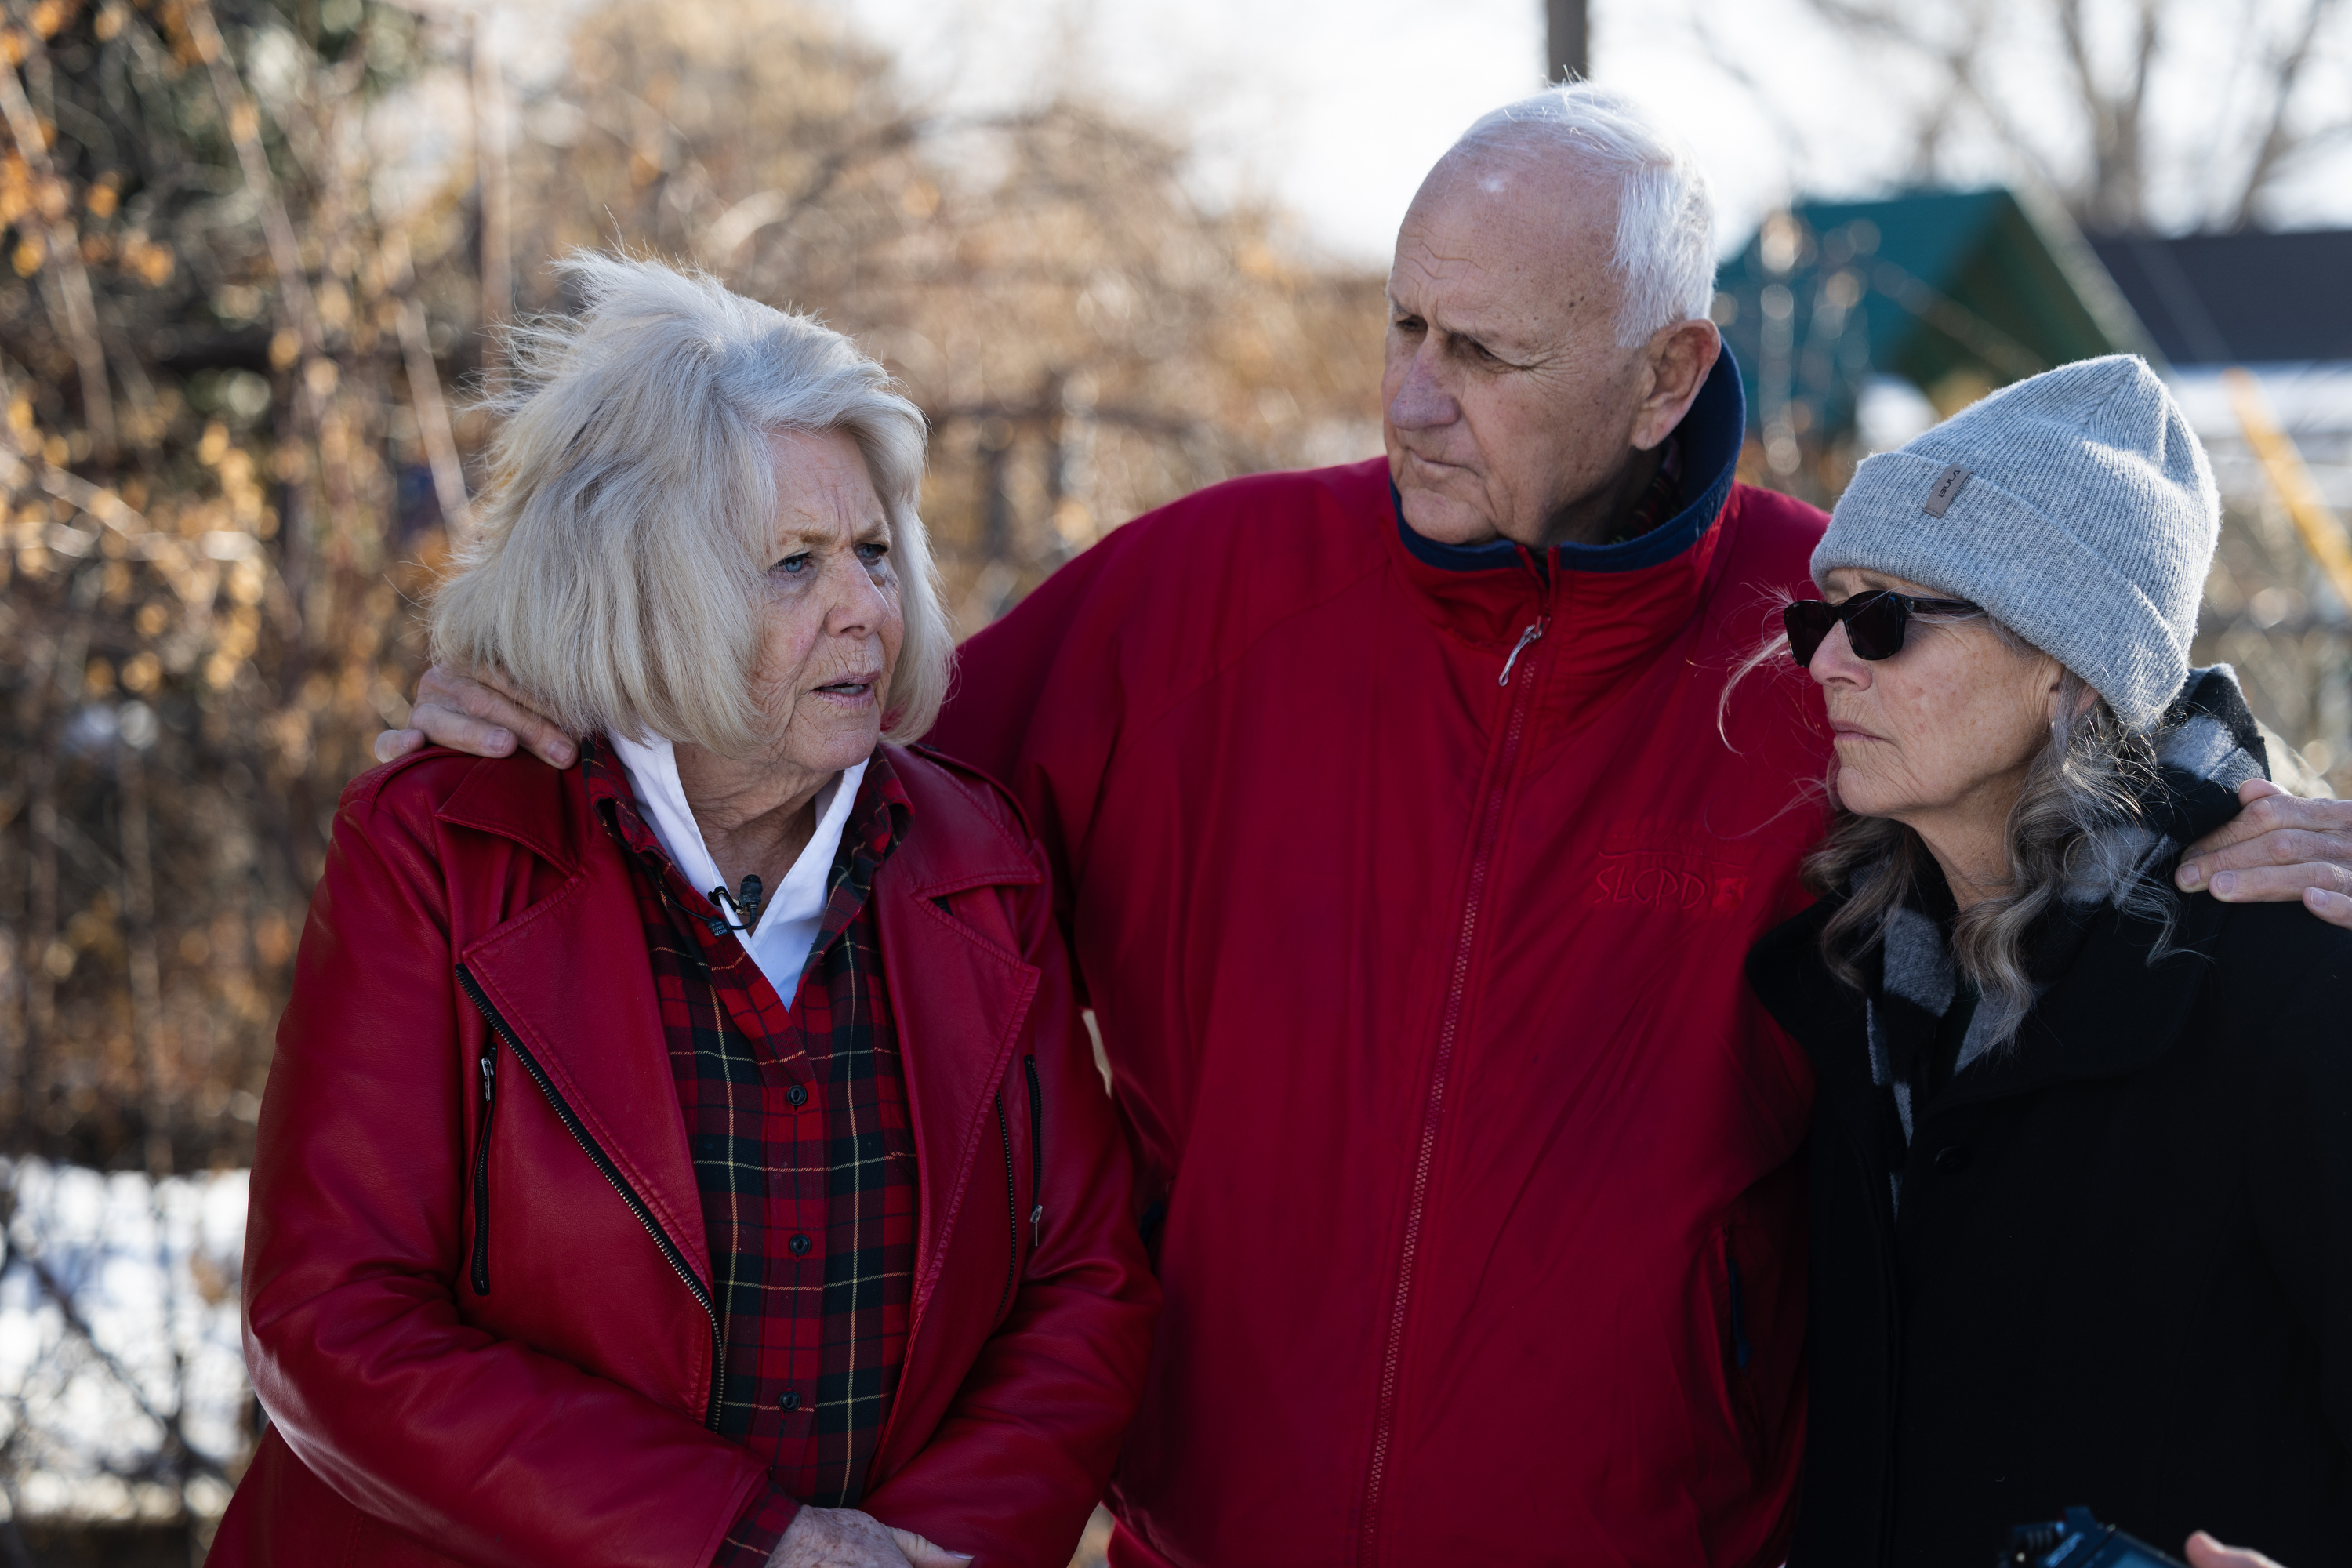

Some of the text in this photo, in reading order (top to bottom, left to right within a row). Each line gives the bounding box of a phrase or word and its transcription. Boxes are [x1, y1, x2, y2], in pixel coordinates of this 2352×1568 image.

[1939, 470, 1962, 498] BULA
[1594, 865, 1706, 909] SLCPD
[713, 927, 728, 936] SON
